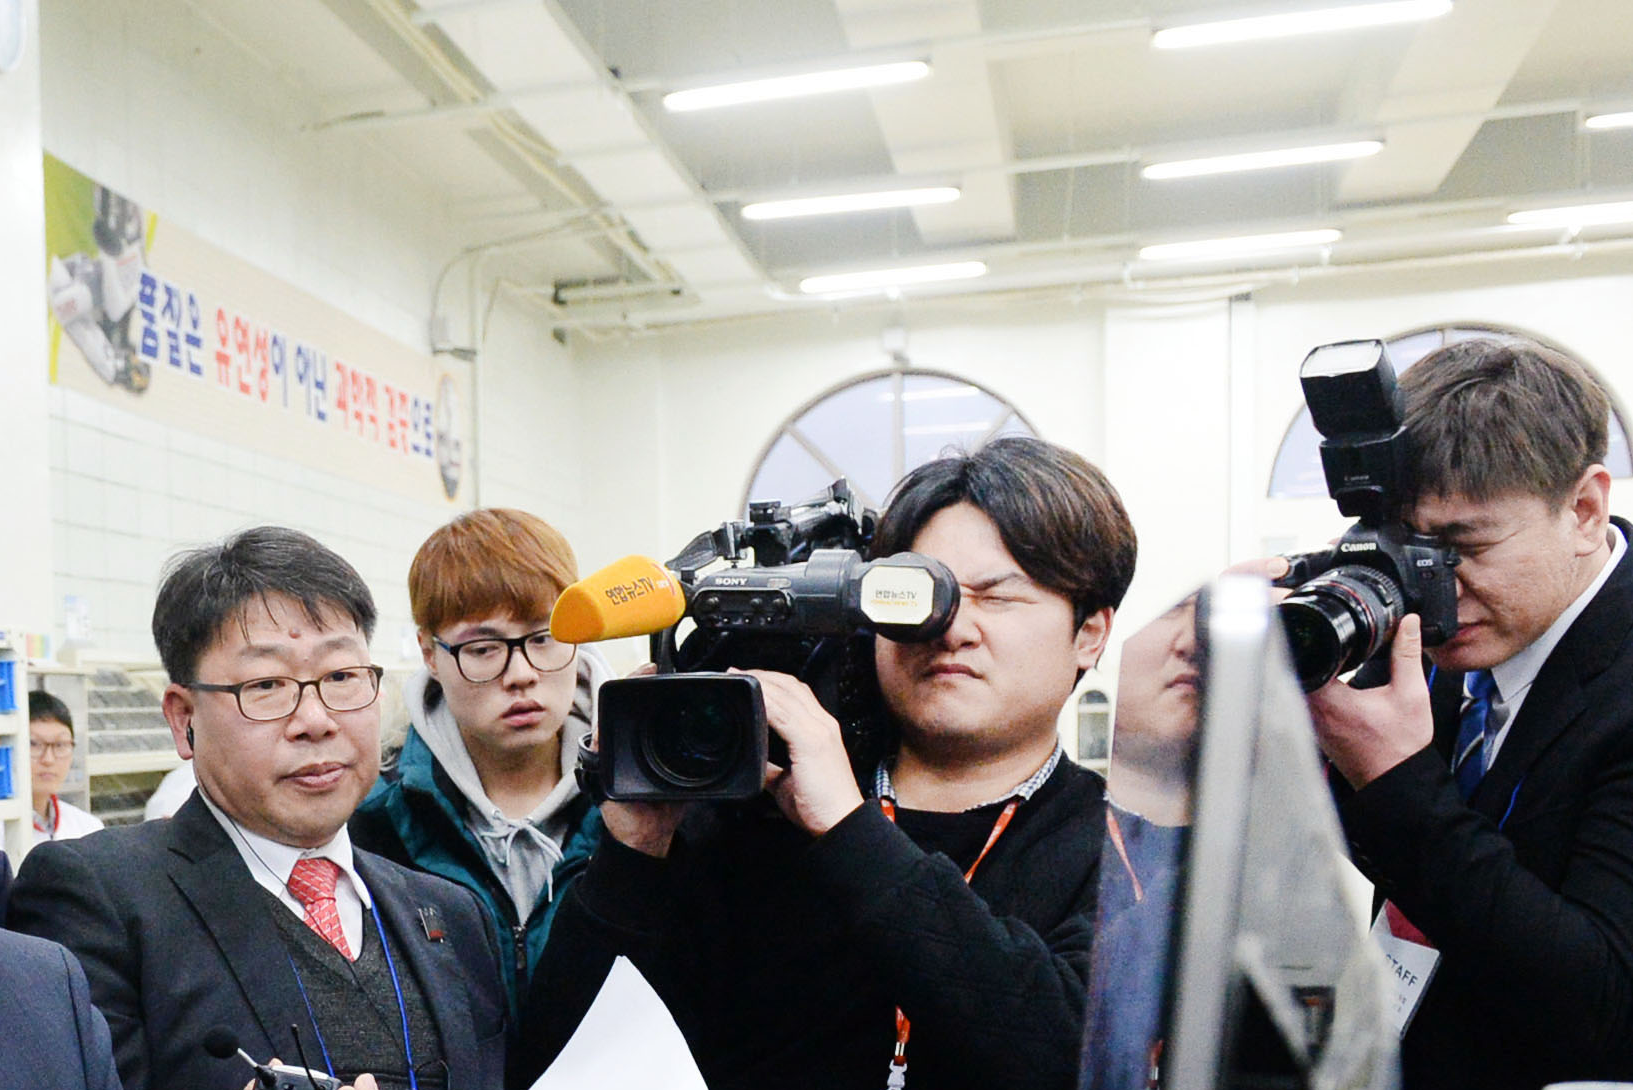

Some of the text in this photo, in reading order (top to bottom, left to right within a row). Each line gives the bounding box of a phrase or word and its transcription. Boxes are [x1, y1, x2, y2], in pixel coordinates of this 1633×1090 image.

[139, 272, 204, 377] 품질은
[214, 307, 289, 409] 유연성이
[296, 345, 328, 422] 아닌
[1340, 542, 1377, 553] Canon
[715, 577, 749, 586] SONY
